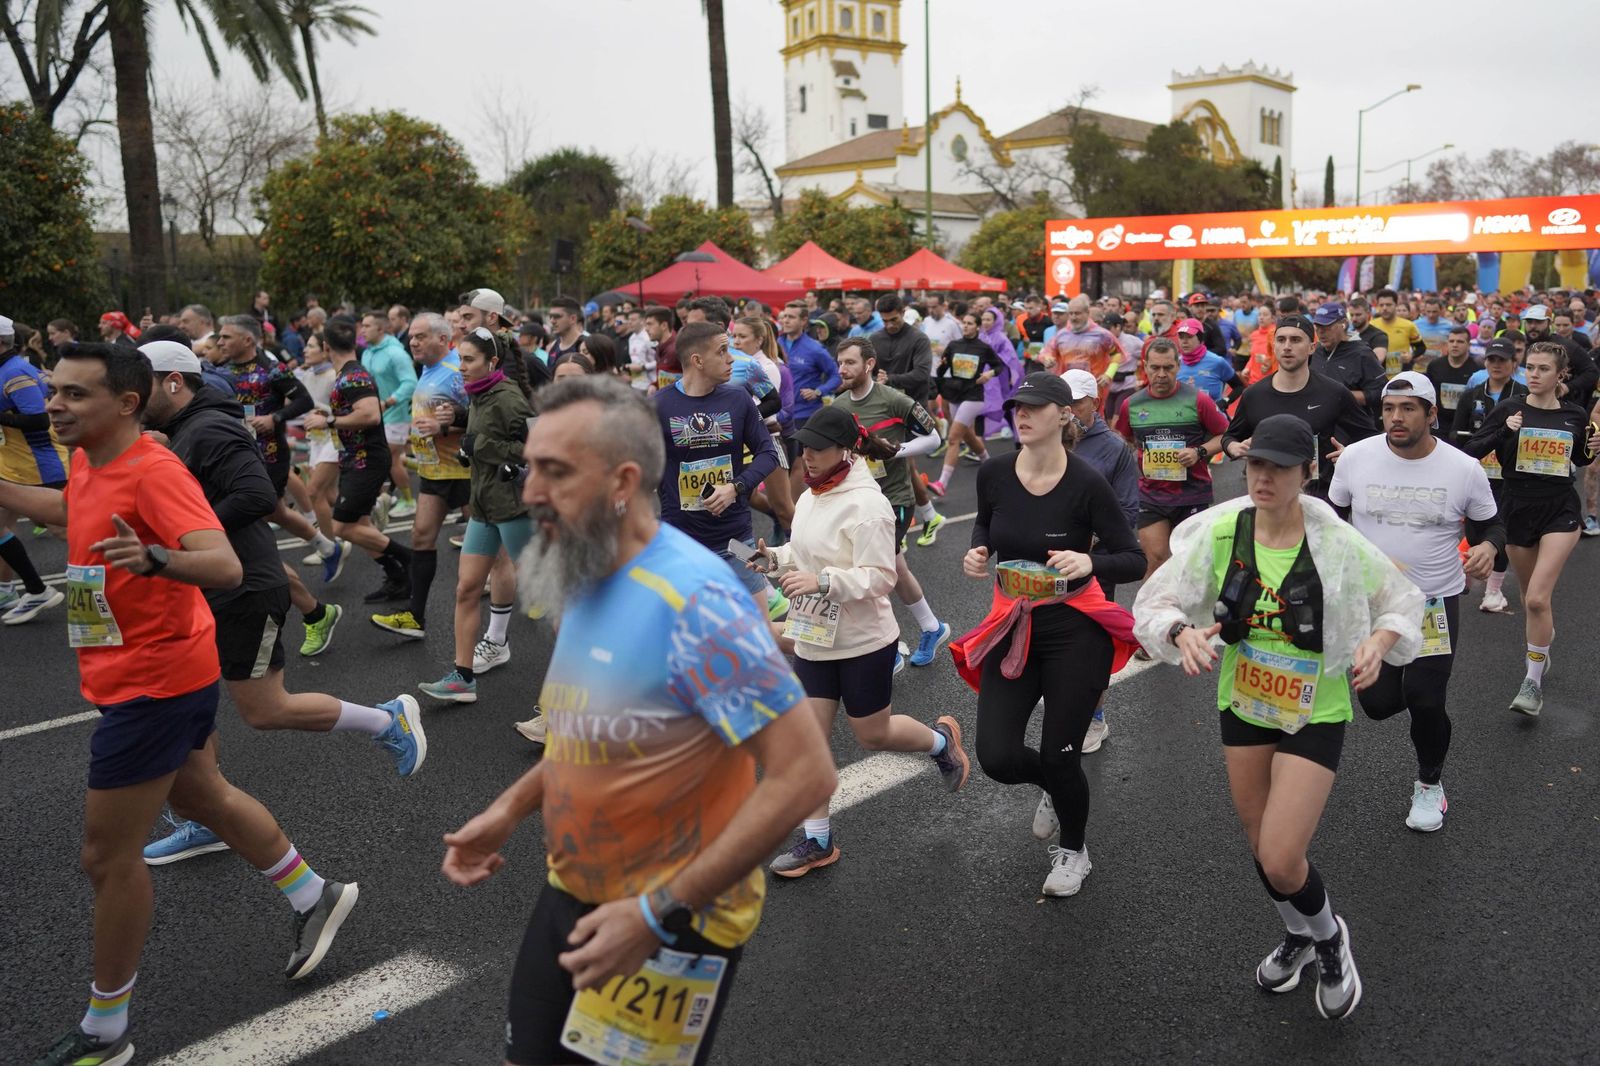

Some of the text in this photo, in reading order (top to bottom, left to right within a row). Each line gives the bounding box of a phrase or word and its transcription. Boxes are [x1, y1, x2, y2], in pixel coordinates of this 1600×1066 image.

[1523, 439, 1565, 456] 14755
[1147, 451, 1181, 464] 13859
[682, 469, 725, 490] 18404
[1240, 661, 1302, 701] 15305
